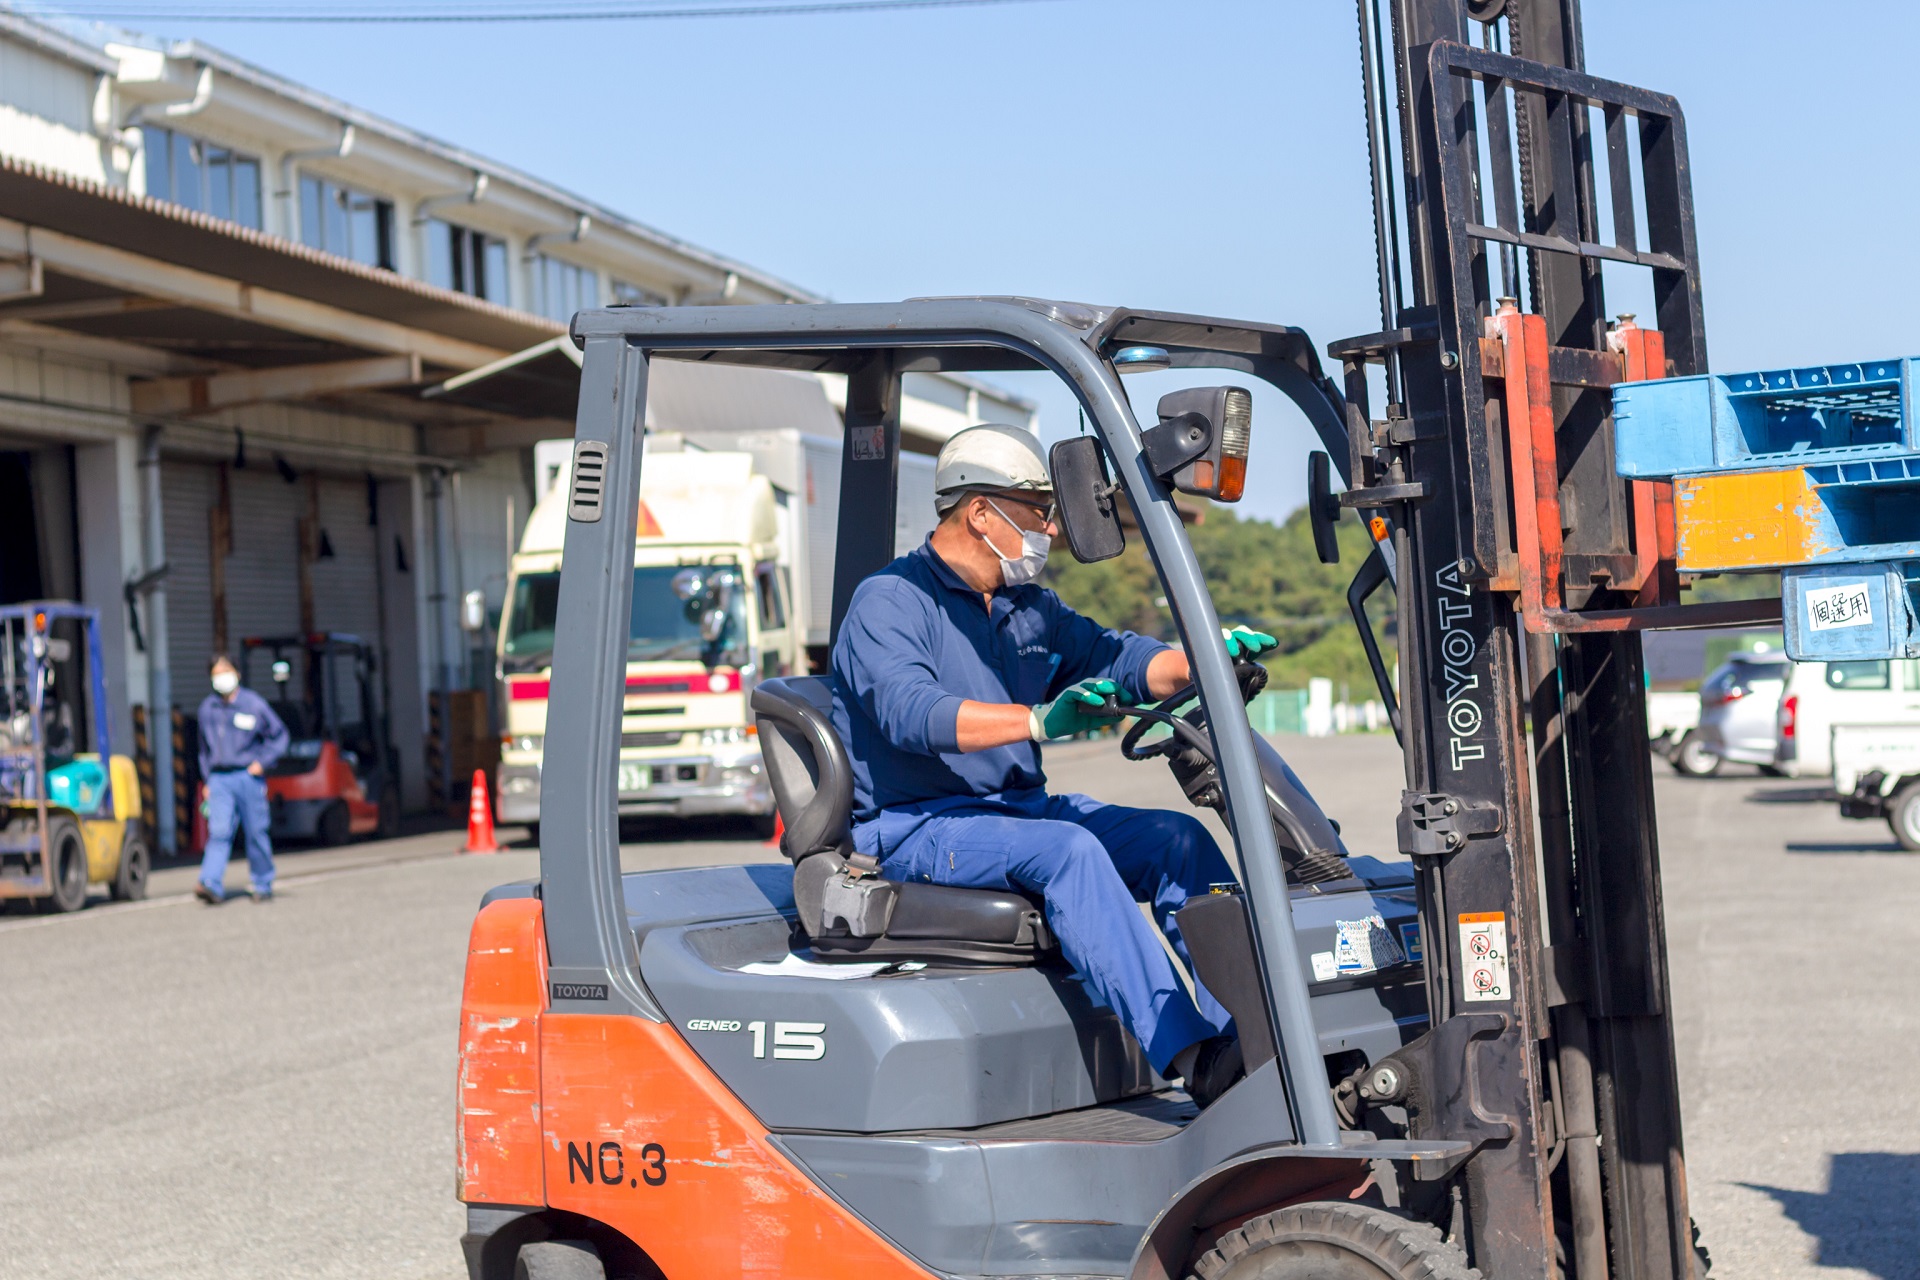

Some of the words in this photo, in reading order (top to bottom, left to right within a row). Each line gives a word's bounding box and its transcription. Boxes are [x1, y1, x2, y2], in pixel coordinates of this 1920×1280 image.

[1436, 560, 1485, 771] TOYOTA
[556, 985, 605, 998] TOYOTA
[687, 1019, 742, 1032] GENEO
[748, 1021, 827, 1061] 15
[567, 1141, 668, 1189] NO.3
